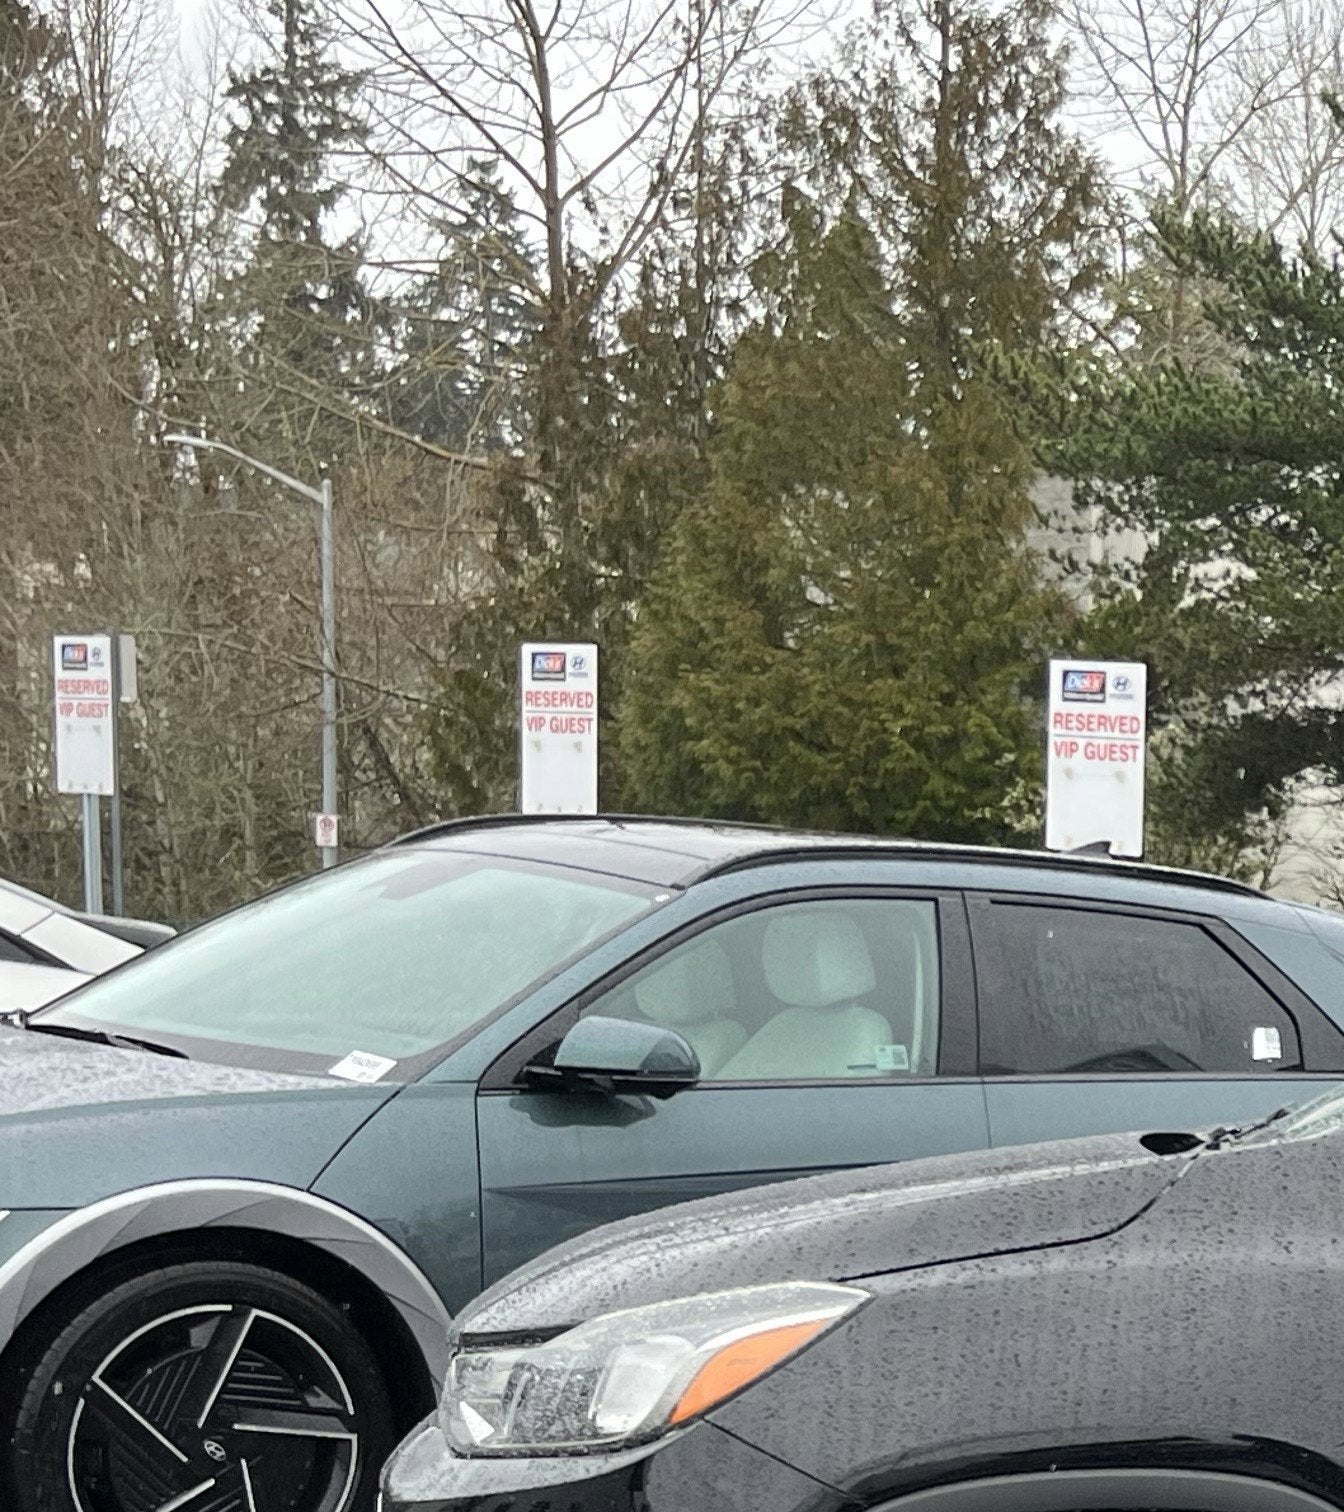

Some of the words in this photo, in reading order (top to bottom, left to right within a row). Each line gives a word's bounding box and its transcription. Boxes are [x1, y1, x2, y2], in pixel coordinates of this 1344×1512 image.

[57, 679, 109, 695] RESERVED
[525, 690, 594, 709] RESERVED
[76, 702, 109, 719] GUEST
[526, 716, 546, 732] VIP
[550, 716, 594, 734] GUEST
[1053, 712, 1141, 735] RESERVED
[1053, 741, 1079, 760] VIP
[1084, 742, 1140, 763] GUEST
